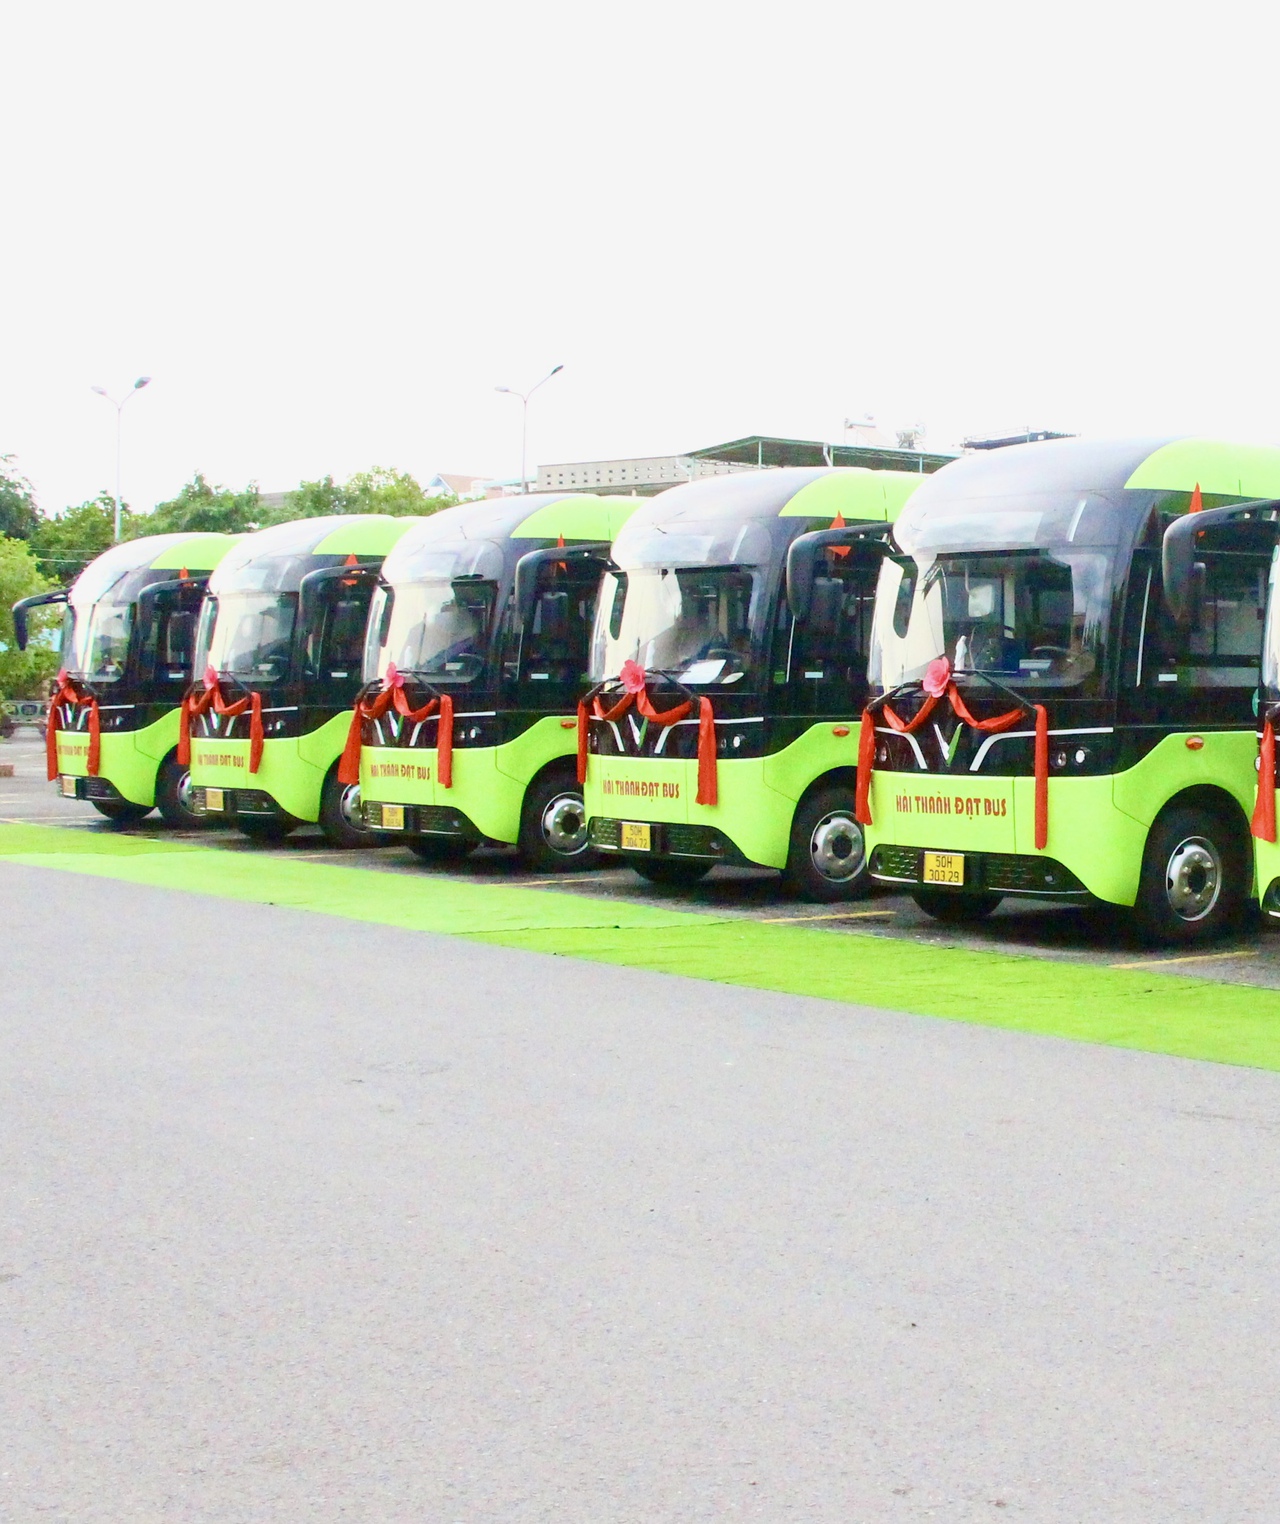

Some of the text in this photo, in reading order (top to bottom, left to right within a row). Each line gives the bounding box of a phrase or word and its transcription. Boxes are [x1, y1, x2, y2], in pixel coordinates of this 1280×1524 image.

[662, 782, 680, 799] BUS
[896, 788, 1007, 820] HẢI THÀNH ĐẠT BUS
[935, 855, 953, 869] 50H
[928, 869, 960, 883] 303.29
